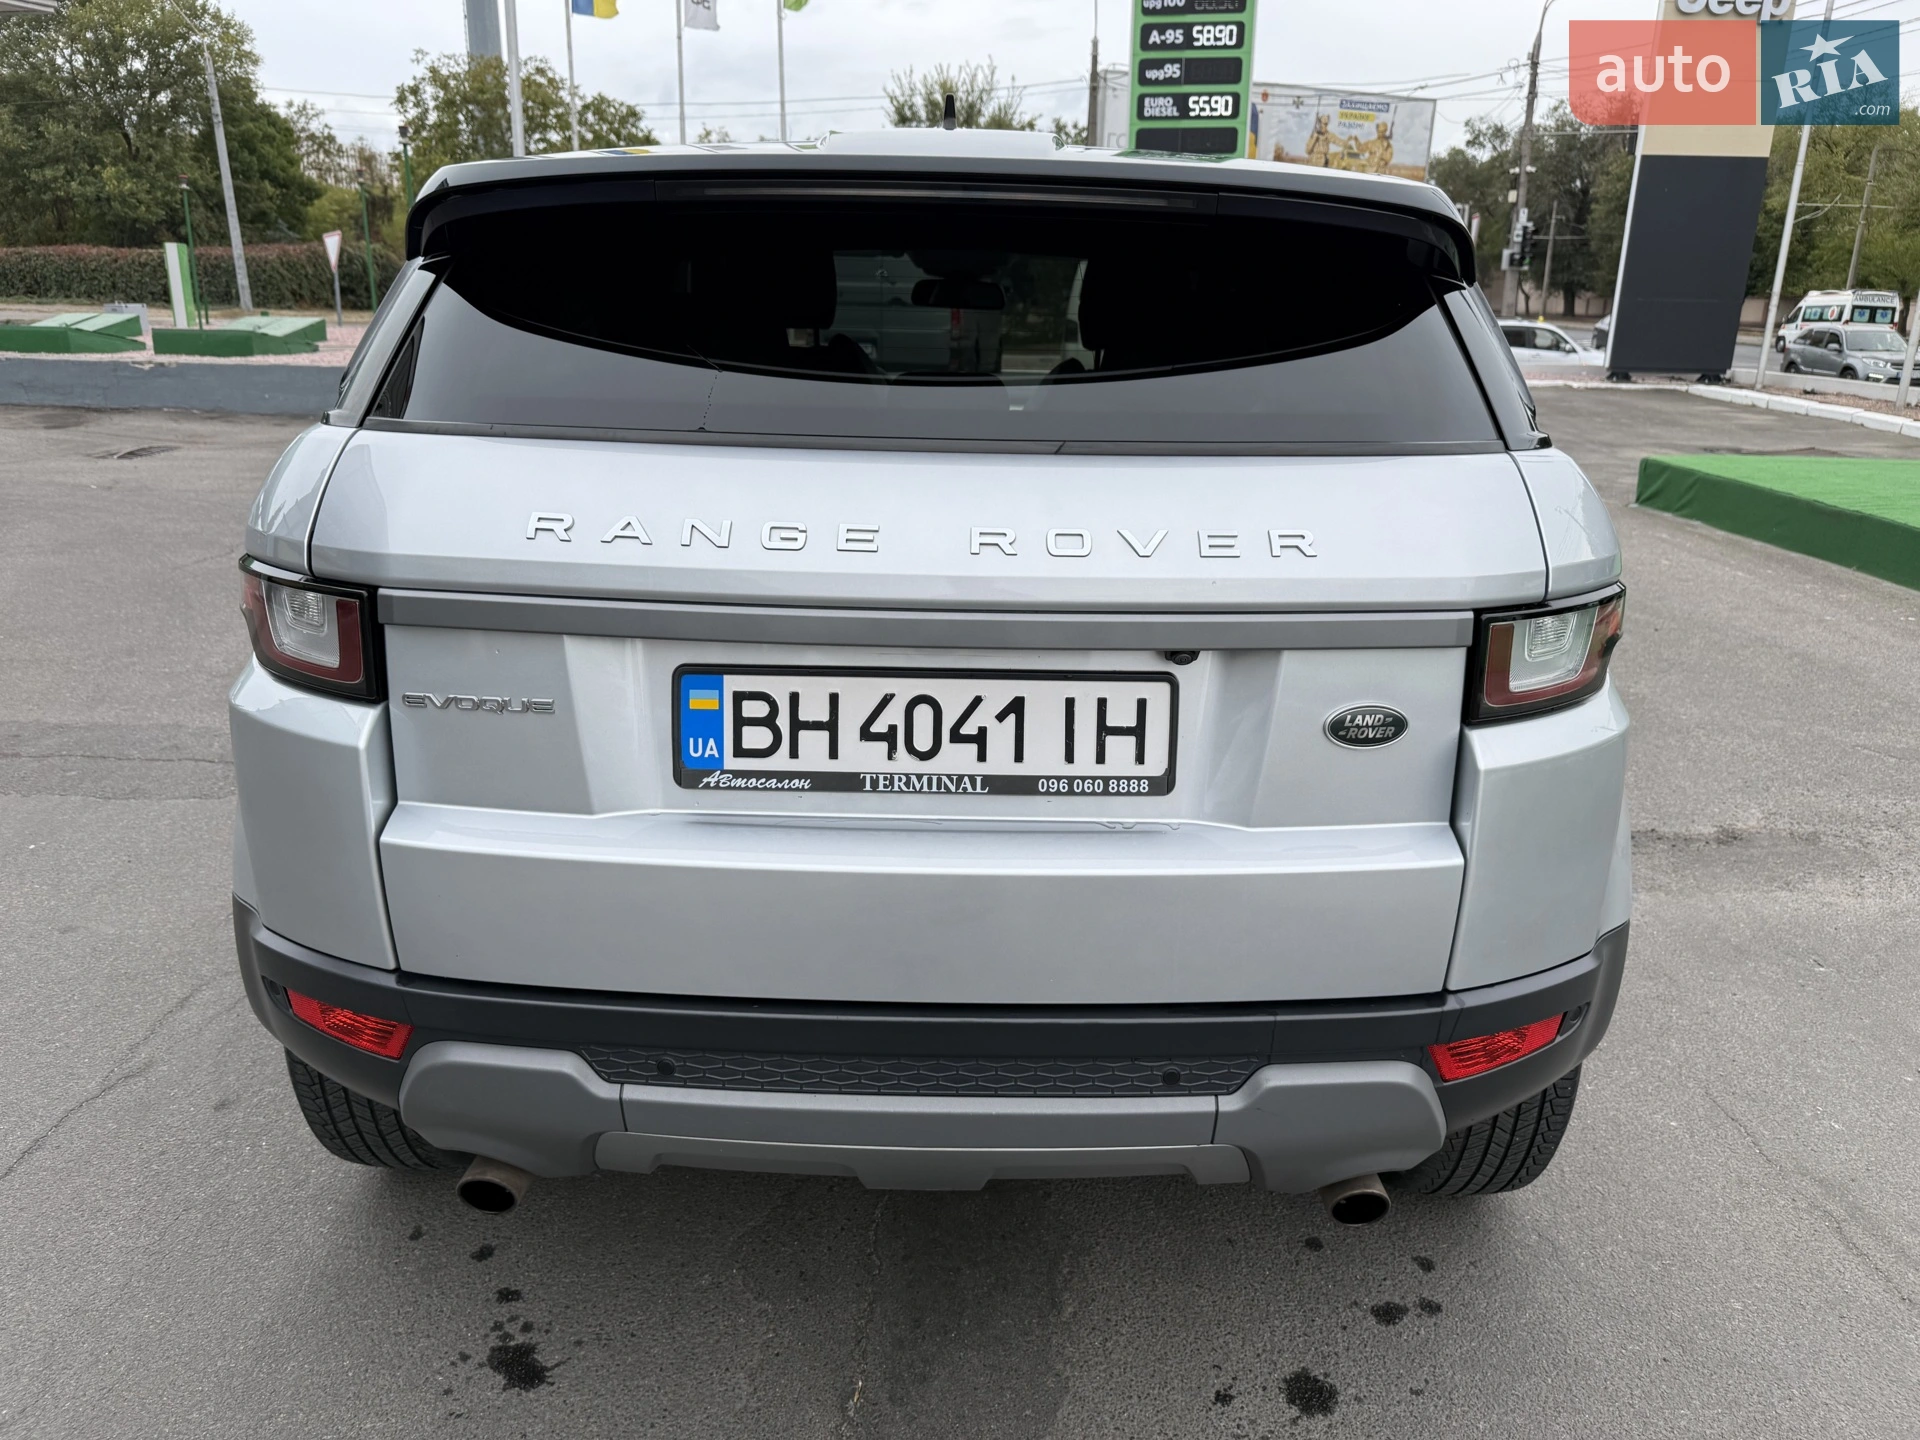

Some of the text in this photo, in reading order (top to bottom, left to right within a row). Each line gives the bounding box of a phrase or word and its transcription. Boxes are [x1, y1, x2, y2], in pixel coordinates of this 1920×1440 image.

[1148, 29, 1184, 45] A-95
[1145, 63, 1181, 80] upg95
[1143, 97, 1173, 107] EURO
[1143, 107, 1180, 118] DIESEL
[1854, 295, 1895, 304] AMBULANCE
[526, 511, 1318, 558] RANGE ROVER
[402, 692, 555, 715] EVOQUE
[859, 693, 1026, 763] 4041
[1344, 714, 1384, 727] LAND
[1346, 726, 1395, 739] ROVER
[689, 737, 719, 758] UA
[860, 772, 989, 794] TERMINAL
[1038, 779, 1150, 793] 096 060 8888
